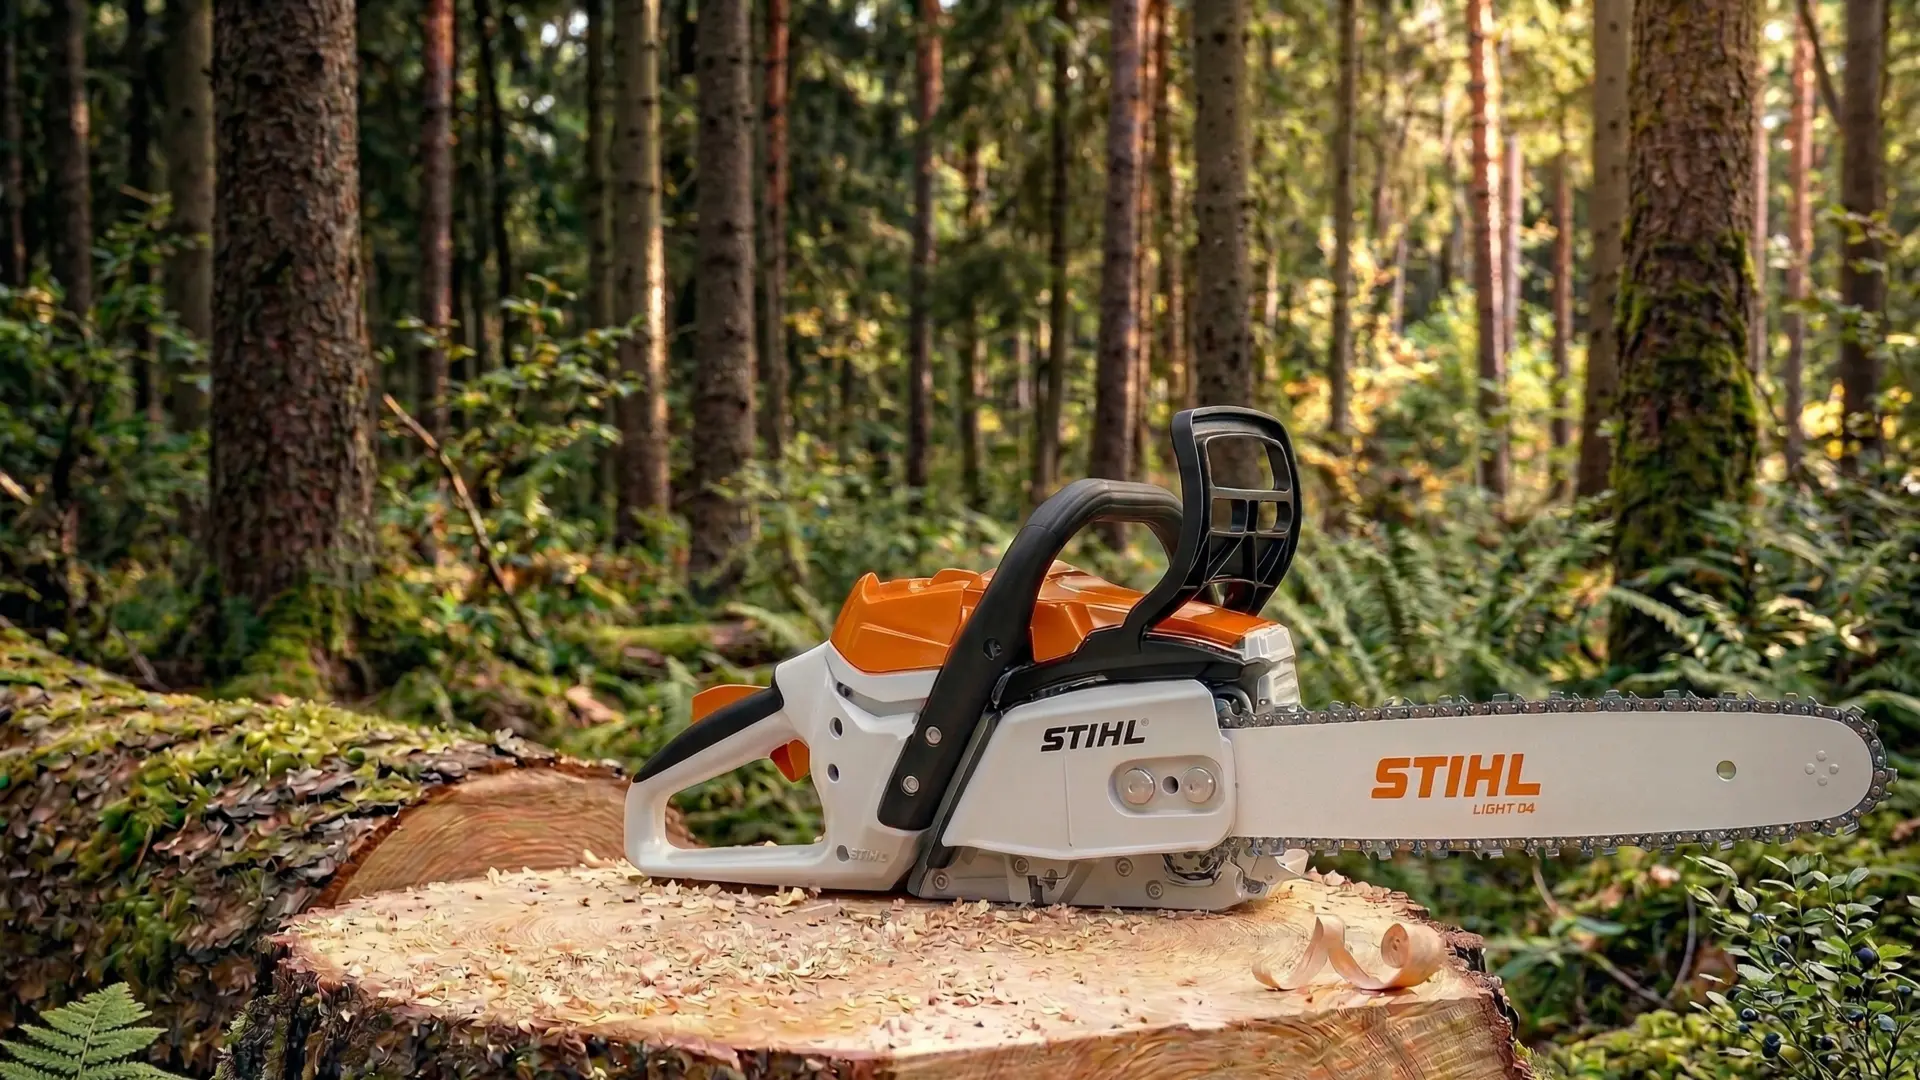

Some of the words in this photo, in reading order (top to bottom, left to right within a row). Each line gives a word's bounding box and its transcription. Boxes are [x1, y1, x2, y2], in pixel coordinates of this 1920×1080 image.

[1371, 753, 1541, 798] STIHL
[1473, 803, 1515, 815] LIGHT
[1517, 802, 1535, 814] 04
